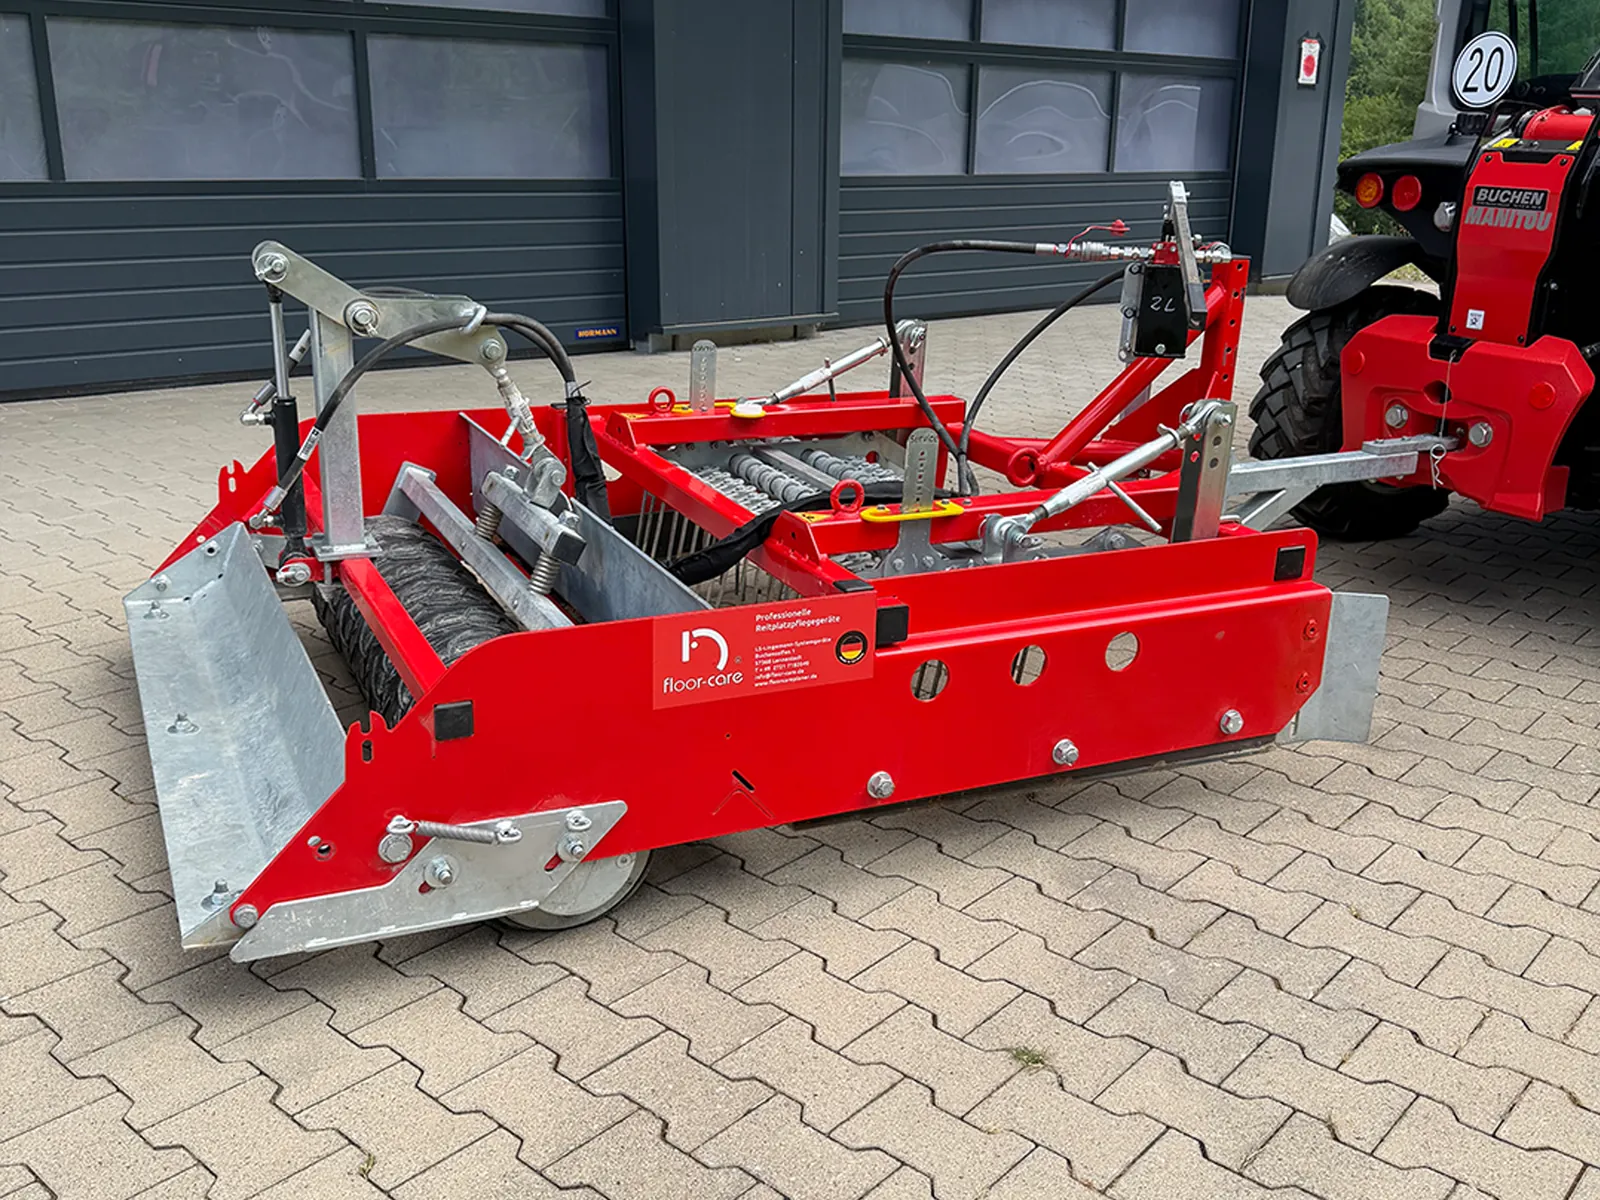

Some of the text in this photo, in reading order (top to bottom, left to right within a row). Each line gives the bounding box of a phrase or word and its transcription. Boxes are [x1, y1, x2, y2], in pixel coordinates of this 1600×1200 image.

[1462, 46, 1504, 93] 20
[1476, 188, 1545, 206] BUCHEN
[1464, 206, 1553, 231] MANITOU
[755, 608, 812, 622] Professionelle
[755, 615, 840, 632] Reitplatzpflegegeräte
[663, 671, 744, 694] floor-care
